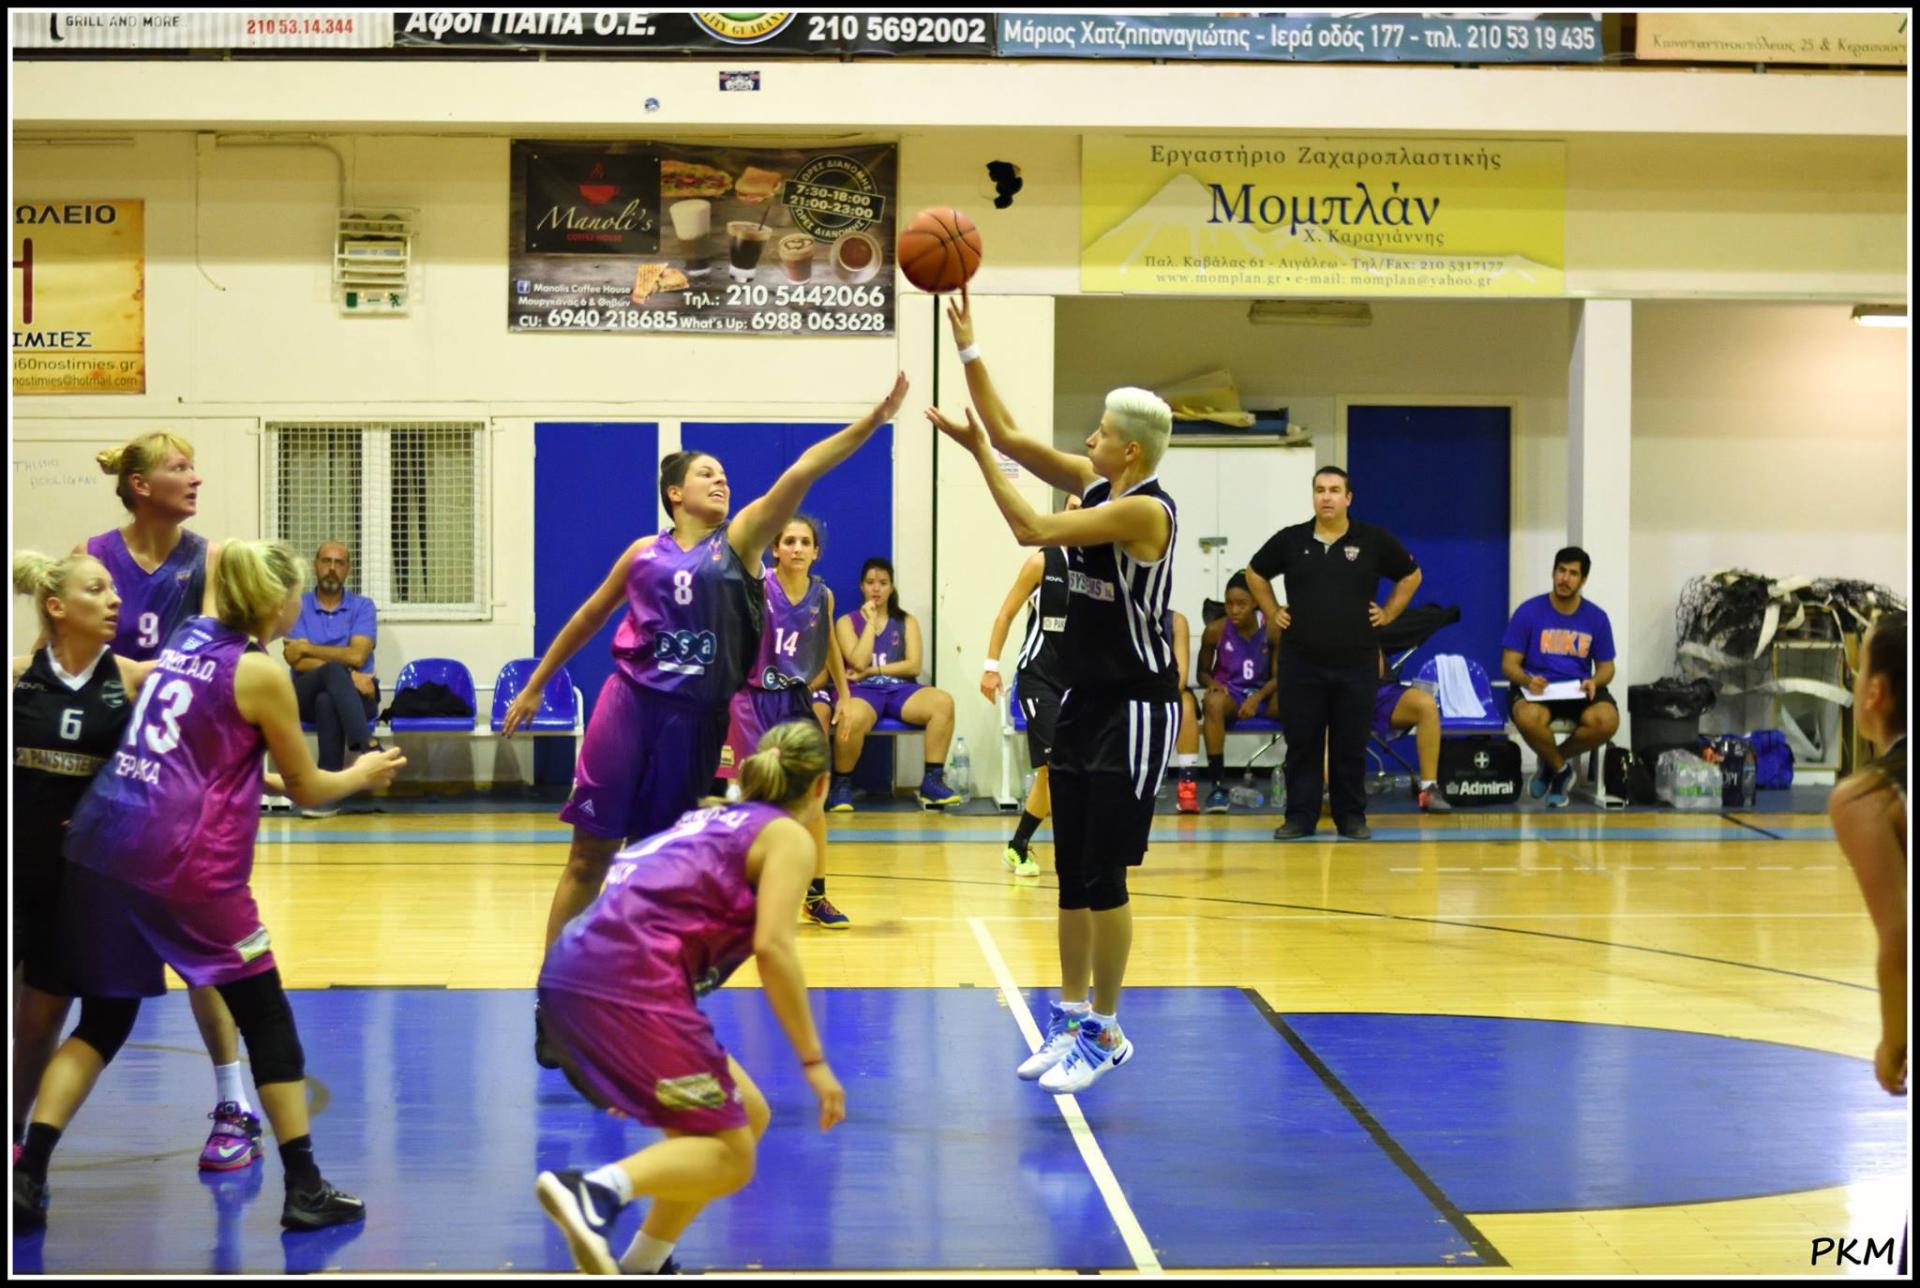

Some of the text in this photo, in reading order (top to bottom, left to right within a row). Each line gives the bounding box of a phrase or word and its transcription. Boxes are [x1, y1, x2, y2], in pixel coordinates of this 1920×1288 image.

[65, 15, 180, 27] GRILL AND MORE
[247, 19, 353, 34] 210 53.14.344
[809, 16, 986, 43] 210 5692002
[1005, 20, 1075, 48] Μάριος
[1081, 21, 1250, 50] Χατζηπαναγιώτης
[1272, 25, 1313, 52] Ιερά
[1319, 25, 1364, 51] οδός
[1371, 26, 1405, 47] 177
[1425, 26, 1462, 51] τηλ.
[1467, 26, 1500, 47] 210
[1506, 26, 1529, 48] 53
[1535, 27, 1556, 49] 19
[1560, 27, 1594, 50] 435
[1820, 37, 1831, 51] &
[1151, 145, 1501, 170] Εργαστήριο Ζαχαροπλαστικής
[797, 184, 871, 206] 7:30-18:00
[15, 204, 117, 224] ΩΛΕΙΟ
[536, 198, 653, 232] Manoli's
[790, 195, 873, 218] 21:00-23:00
[1207, 181, 1440, 235] Μομπλάν
[1329, 228, 1445, 247] Καραγιάννης
[1144, 256, 1178, 267] Παλ.
[1184, 256, 1245, 269] Καβάλας
[1278, 257, 1337, 270] Αιγάλεω
[1421, 262, 1445, 270] 210
[1450, 261, 1503, 272] 5317177
[533, 283, 569, 293] Manolis
[571, 284, 600, 293] Coffee
[603, 285, 631, 294] House
[1156, 273, 1492, 287] www.momplan.gr e-mail: momplan@yahoo.gr
[580, 298, 587, 306] 6
[683, 285, 885, 309] Τηλ.: 210 5442066
[519, 309, 678, 329] CU: 6940 218685
[680, 312, 885, 331] What's Up: 6988 063628
[674, 570, 693, 605] 8
[138, 612, 159, 648] 9
[775, 628, 799, 656] 14
[1540, 629, 1593, 657] NIKE
[1243, 660, 1254, 680] 6
[60, 708, 84, 740] 6
[128, 672, 194, 754] 13
[1460, 781, 1513, 796] Admiral
